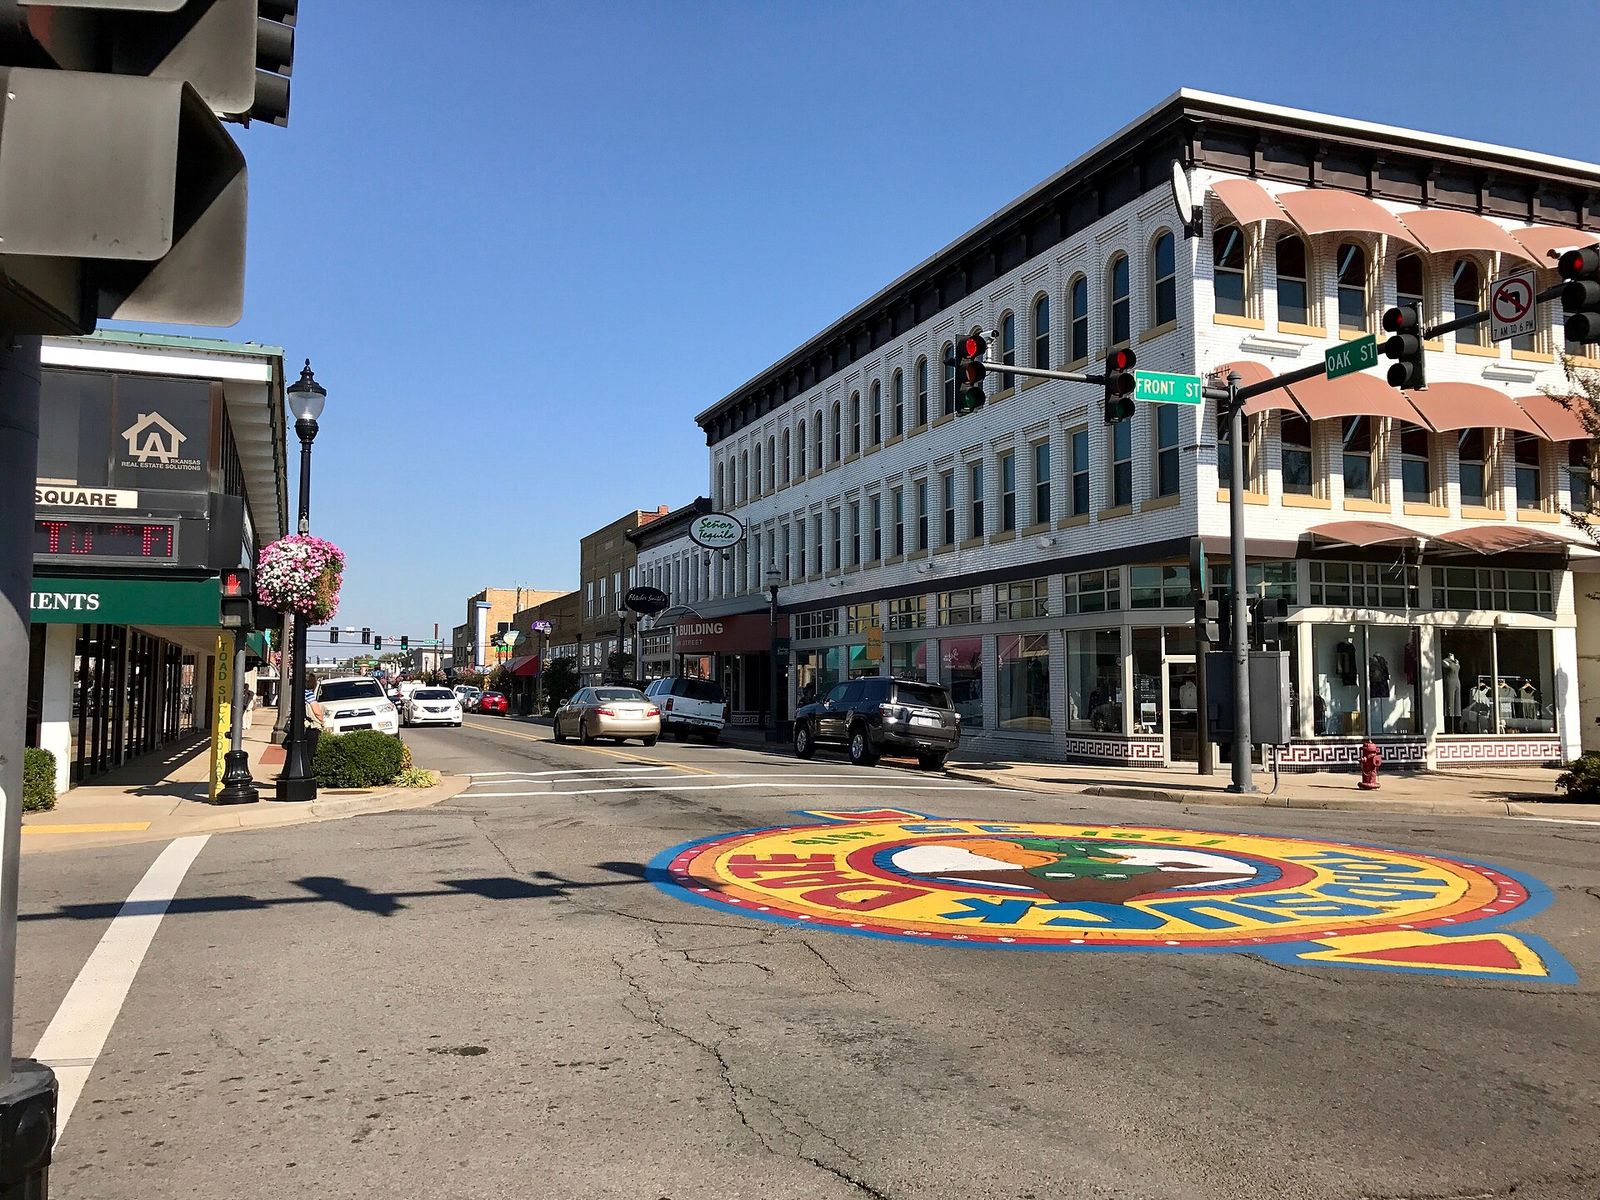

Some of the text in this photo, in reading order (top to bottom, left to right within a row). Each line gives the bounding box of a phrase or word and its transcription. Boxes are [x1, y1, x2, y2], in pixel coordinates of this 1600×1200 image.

[1493, 328, 1498, 339] 7
[1500, 326, 1508, 336] AM
[1519, 322, 1524, 332] 6
[1525, 319, 1534, 330] PM
[1327, 342, 1375, 372] OAK ST
[1136, 377, 1200, 399] FRONT ST
[140, 462, 164, 470] ESTATE
[165, 463, 201, 471] SOLUTIONS
[34, 489, 117, 507] SQUARE
[700, 517, 735, 530] Señor
[698, 529, 736, 542] Tequila
[679, 622, 724, 636] BUILDING
[218, 642, 228, 681] TOAD
[218, 686, 228, 724] SUCK
[727, 852, 935, 911] DAZE
